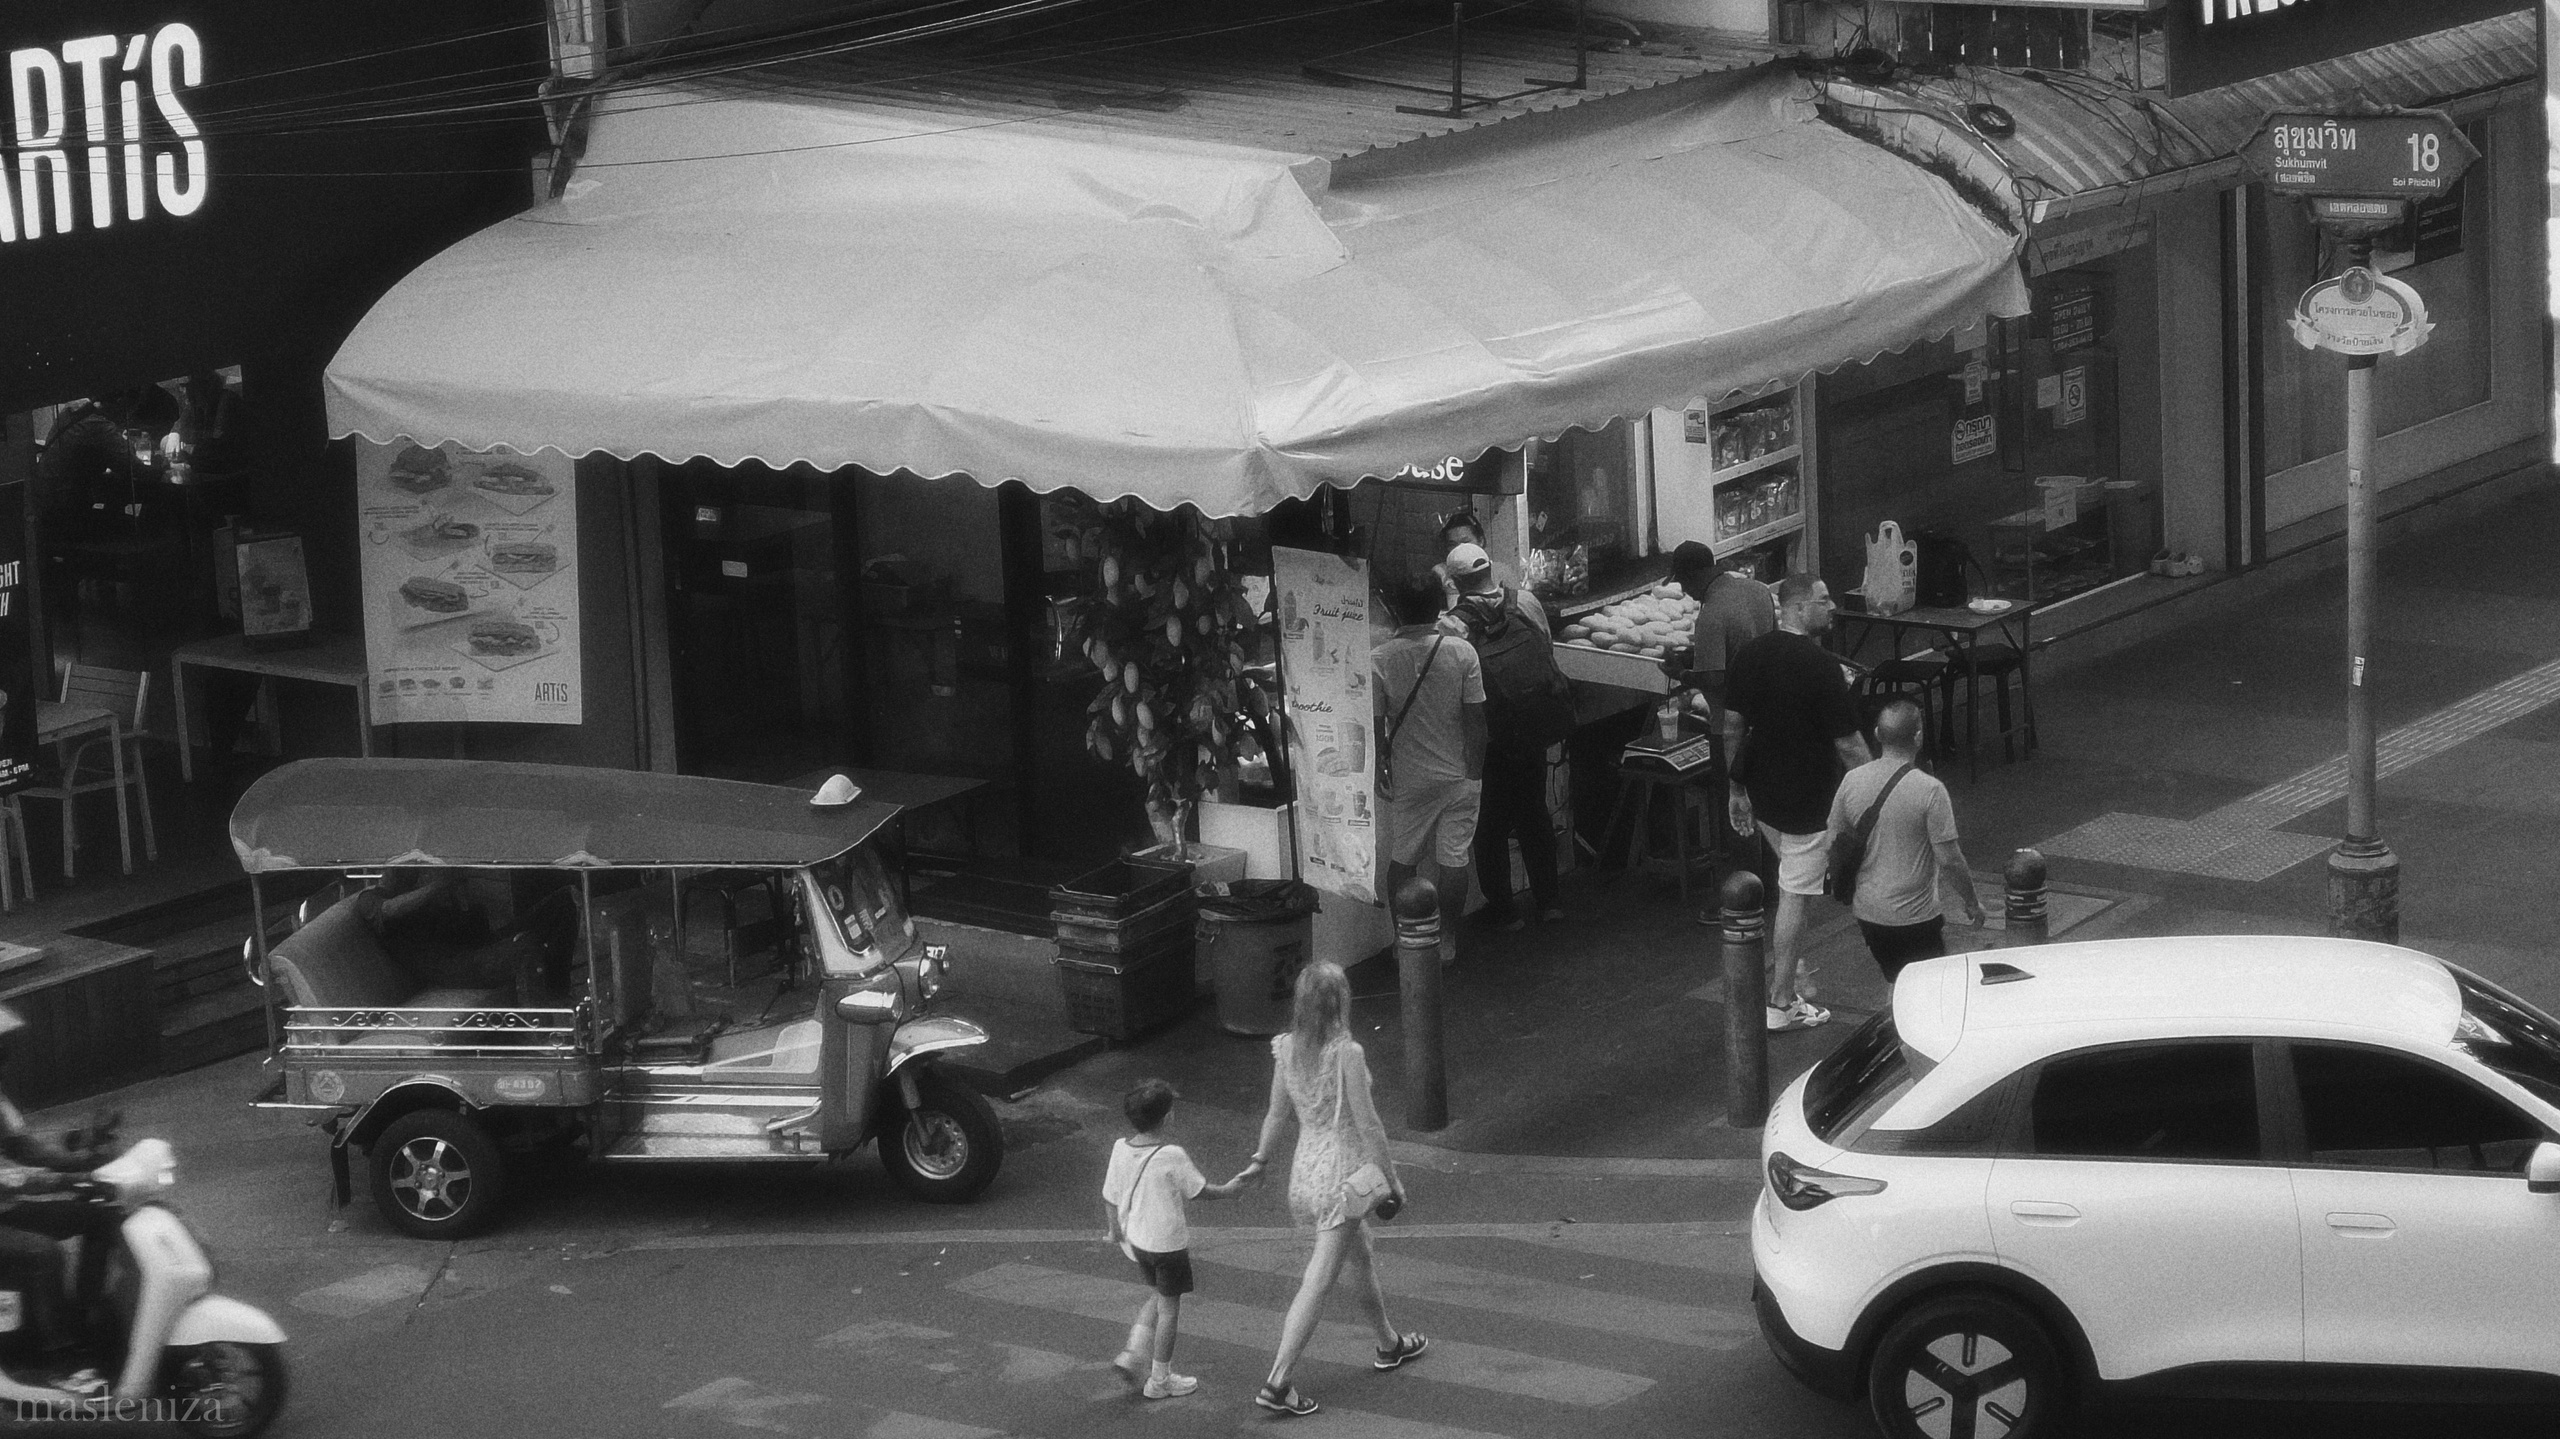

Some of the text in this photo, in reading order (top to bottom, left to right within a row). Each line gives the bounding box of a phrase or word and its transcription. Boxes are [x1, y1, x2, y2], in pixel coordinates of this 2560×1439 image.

[2274, 120, 2440, 172] สุขุมวิท 18
[2275, 157, 2327, 169] Sukhumvit
[2392, 178, 2406, 187] Soi
[1313, 604, 1364, 622] Fruit juice
